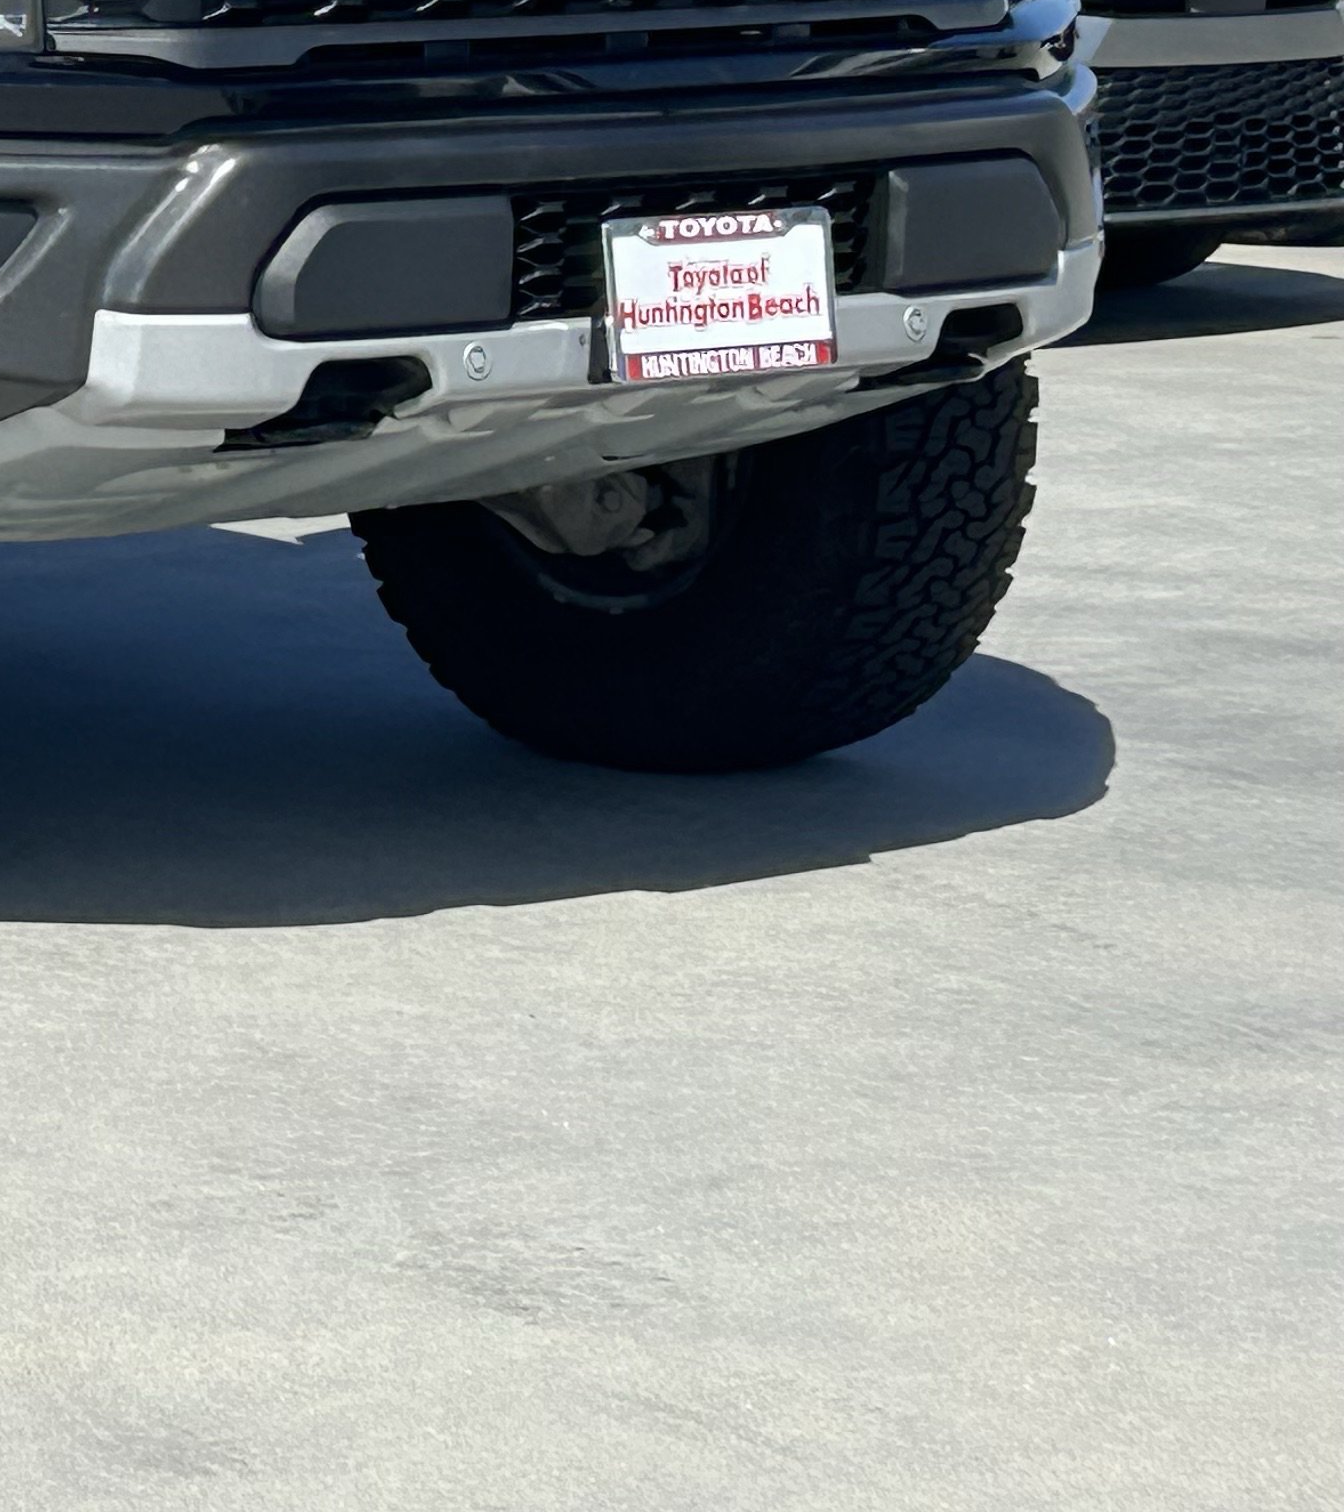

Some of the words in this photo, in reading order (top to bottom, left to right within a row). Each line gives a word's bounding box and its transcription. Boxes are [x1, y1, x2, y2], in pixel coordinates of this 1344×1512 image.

[659, 214, 774, 239] TOYOTA
[747, 285, 821, 321] Beach
[641, 346, 755, 379] HUNTINGTON
[759, 343, 818, 368] BEACH
